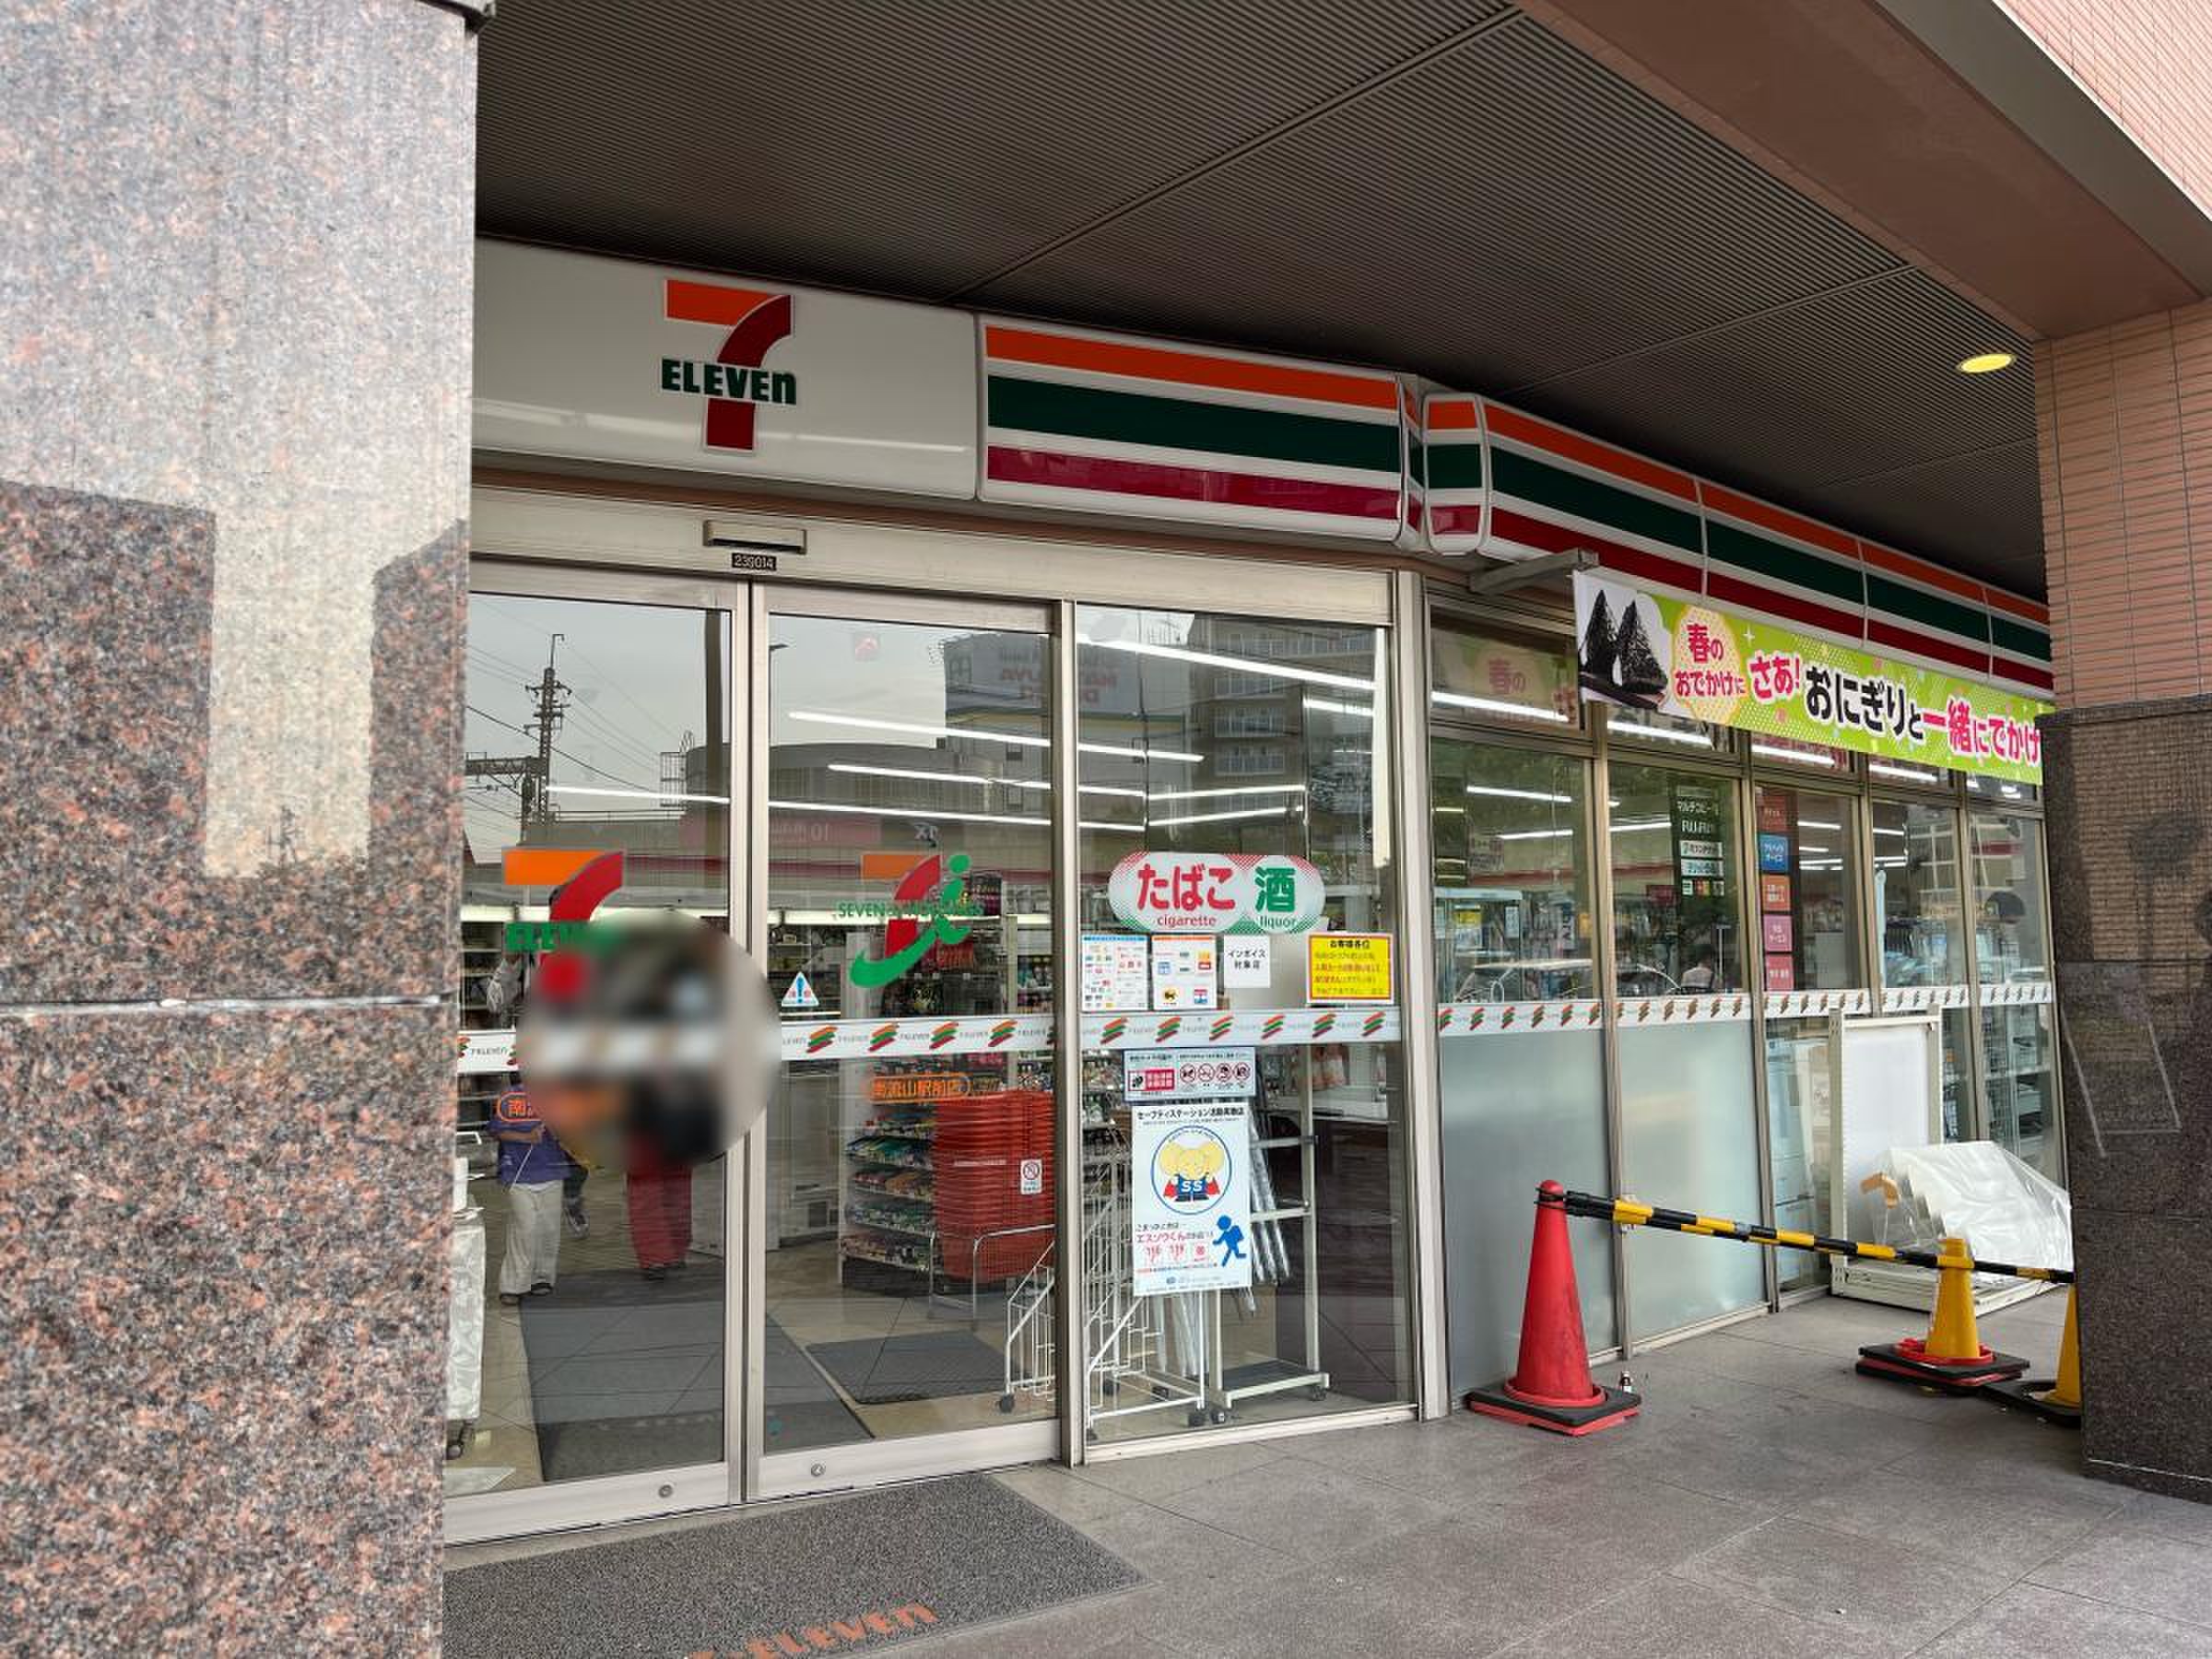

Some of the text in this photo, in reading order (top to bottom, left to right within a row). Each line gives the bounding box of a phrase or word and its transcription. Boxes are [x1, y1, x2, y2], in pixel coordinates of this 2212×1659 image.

[1687, 623, 1724, 665] 春の
[1675, 669, 1747, 697] おでかけに
[1137, 864, 1236, 911] たばこ
[1254, 867, 1296, 912] 酒
[1157, 915, 1217, 930] cigarette
[1260, 915, 1298, 930] liquor
[1181, 1180, 1203, 1193] SS
